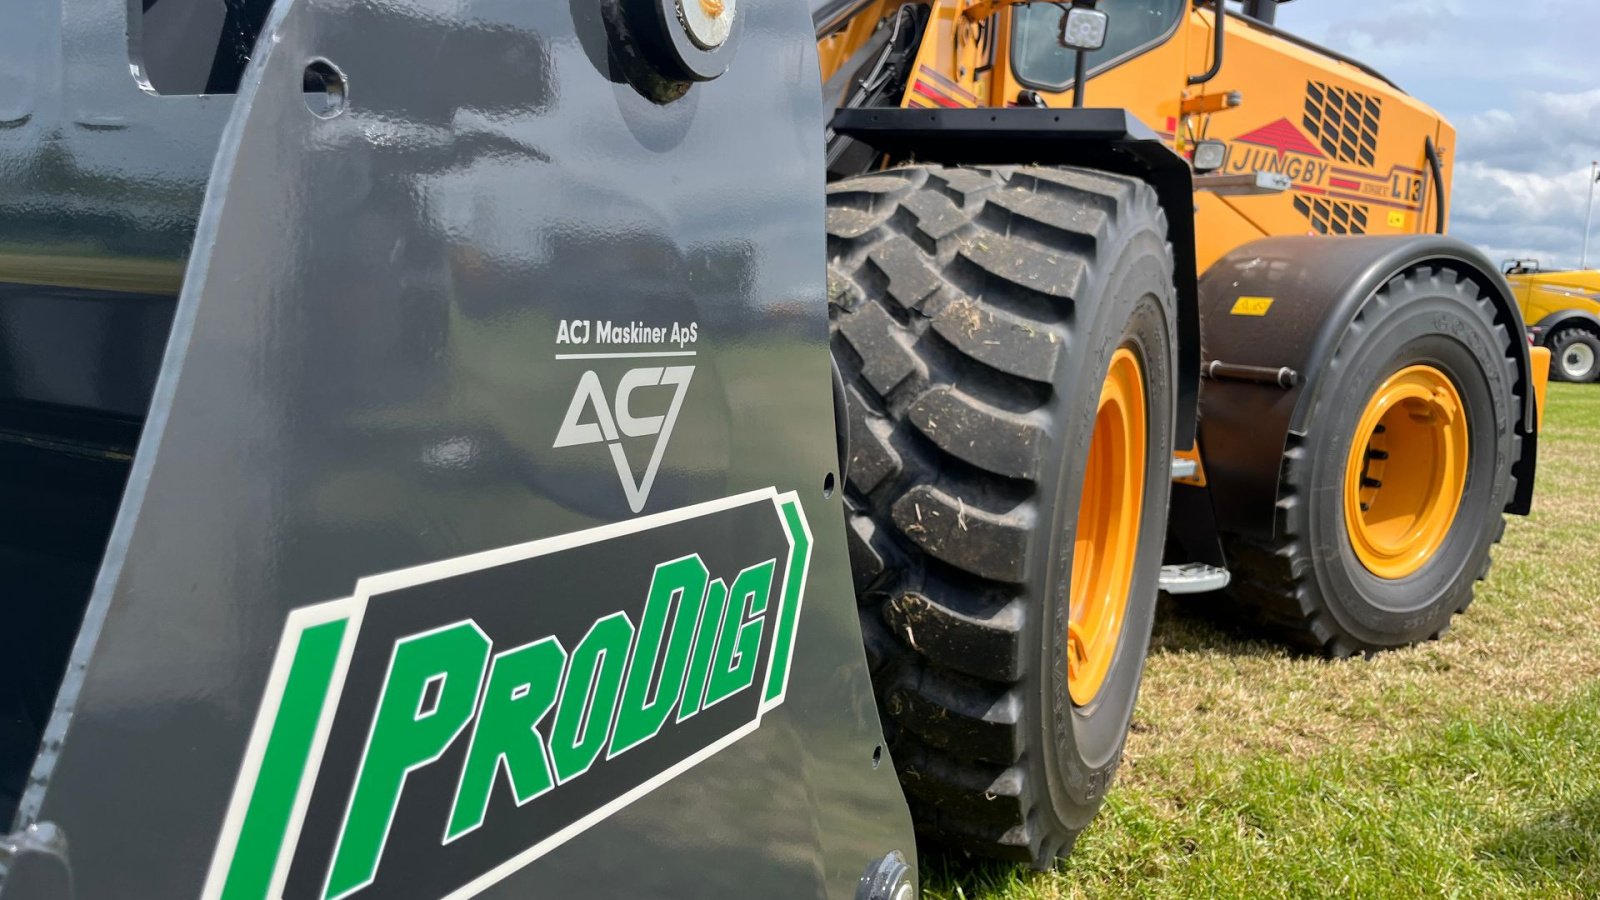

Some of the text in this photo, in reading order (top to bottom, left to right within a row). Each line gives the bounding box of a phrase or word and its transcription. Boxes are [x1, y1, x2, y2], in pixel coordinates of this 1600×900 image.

[556, 319, 698, 348] ACJ Maskiner ApS
